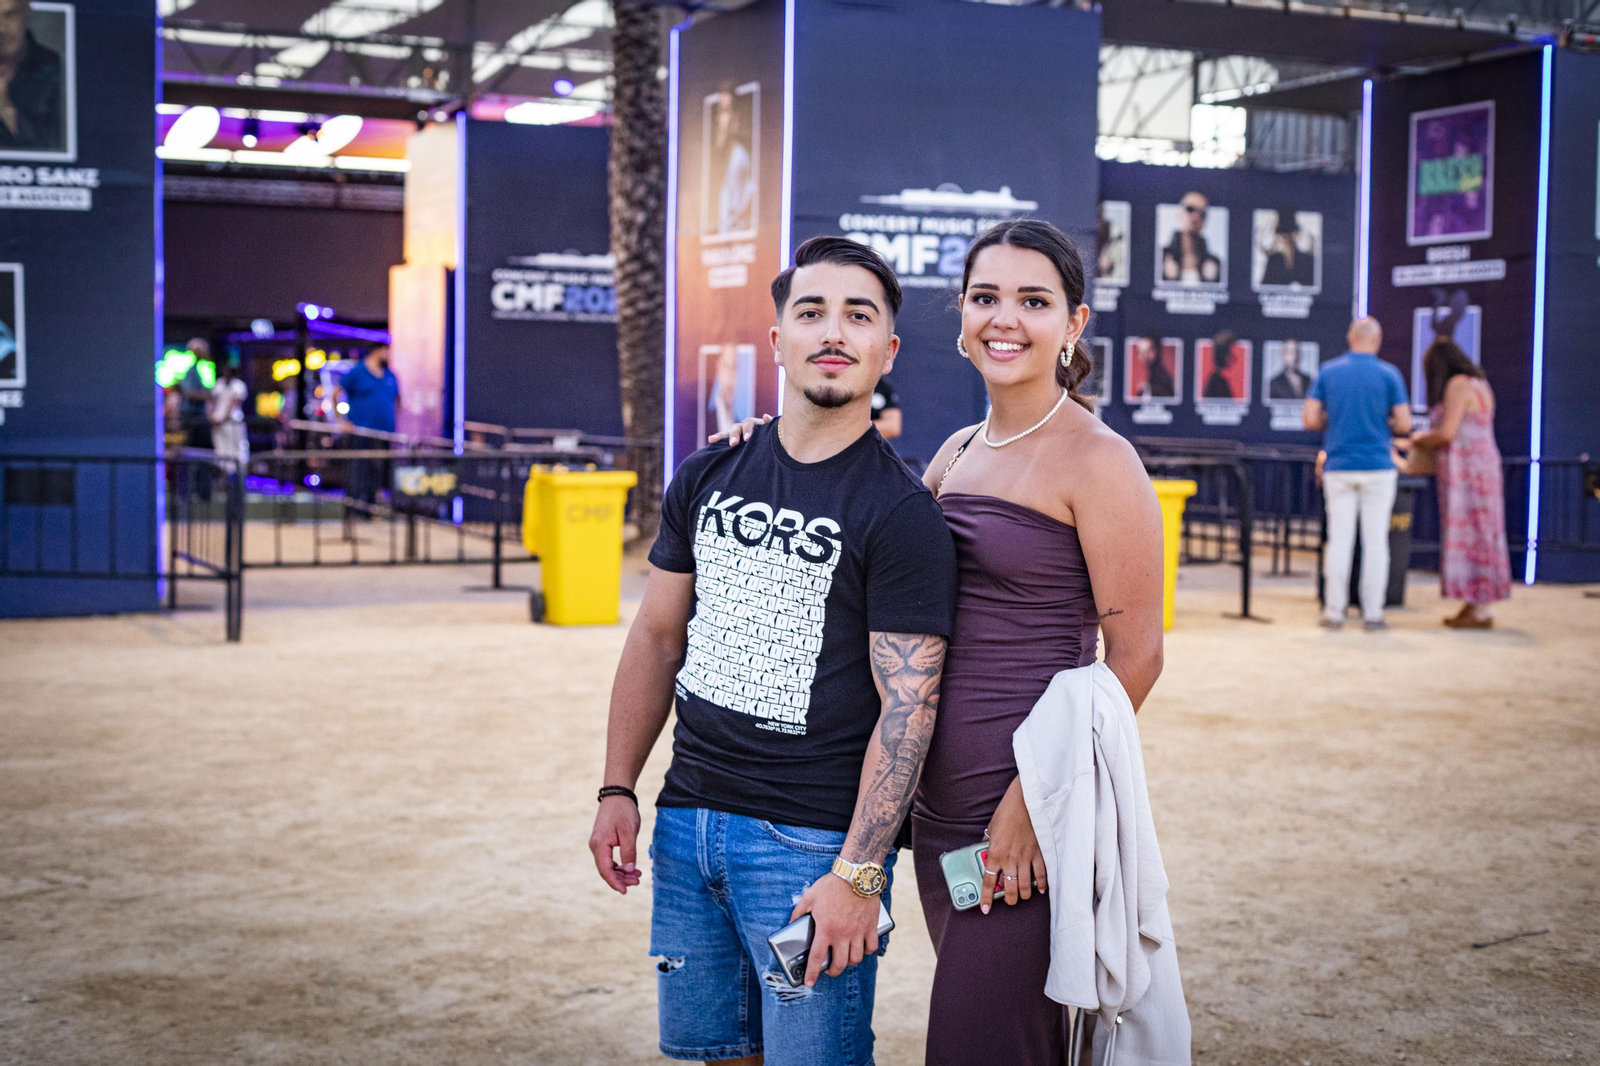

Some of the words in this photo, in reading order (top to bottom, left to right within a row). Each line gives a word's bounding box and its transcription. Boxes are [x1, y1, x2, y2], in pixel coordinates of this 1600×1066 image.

[839, 213, 919, 233] CONCERT
[921, 217, 975, 236] MUSIC
[566, 504, 614, 522] CMF
[700, 490, 842, 564] KORS
